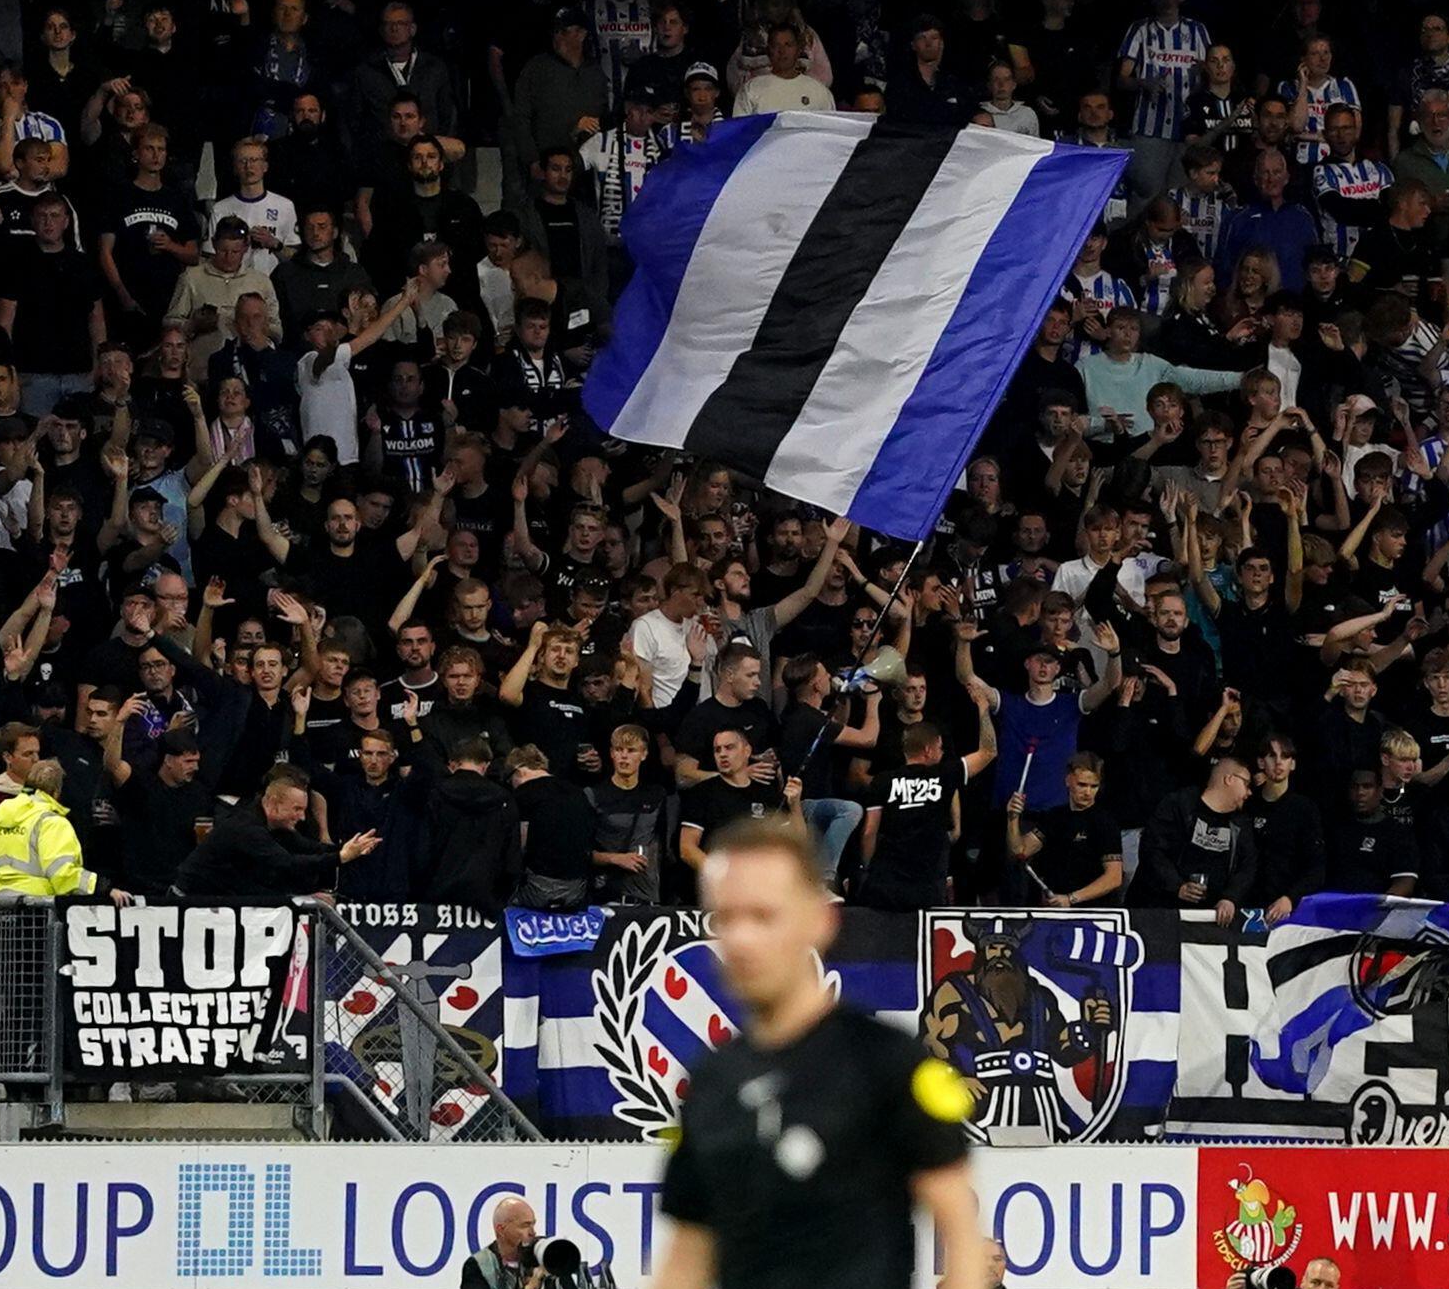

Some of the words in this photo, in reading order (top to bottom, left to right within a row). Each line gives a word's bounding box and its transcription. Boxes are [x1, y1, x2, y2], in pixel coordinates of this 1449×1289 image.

[384, 436, 435, 451] WOLKOM
[887, 776, 944, 804] MF25
[66, 904, 294, 990] STOP
[992, 1180, 1186, 1276] OUP
